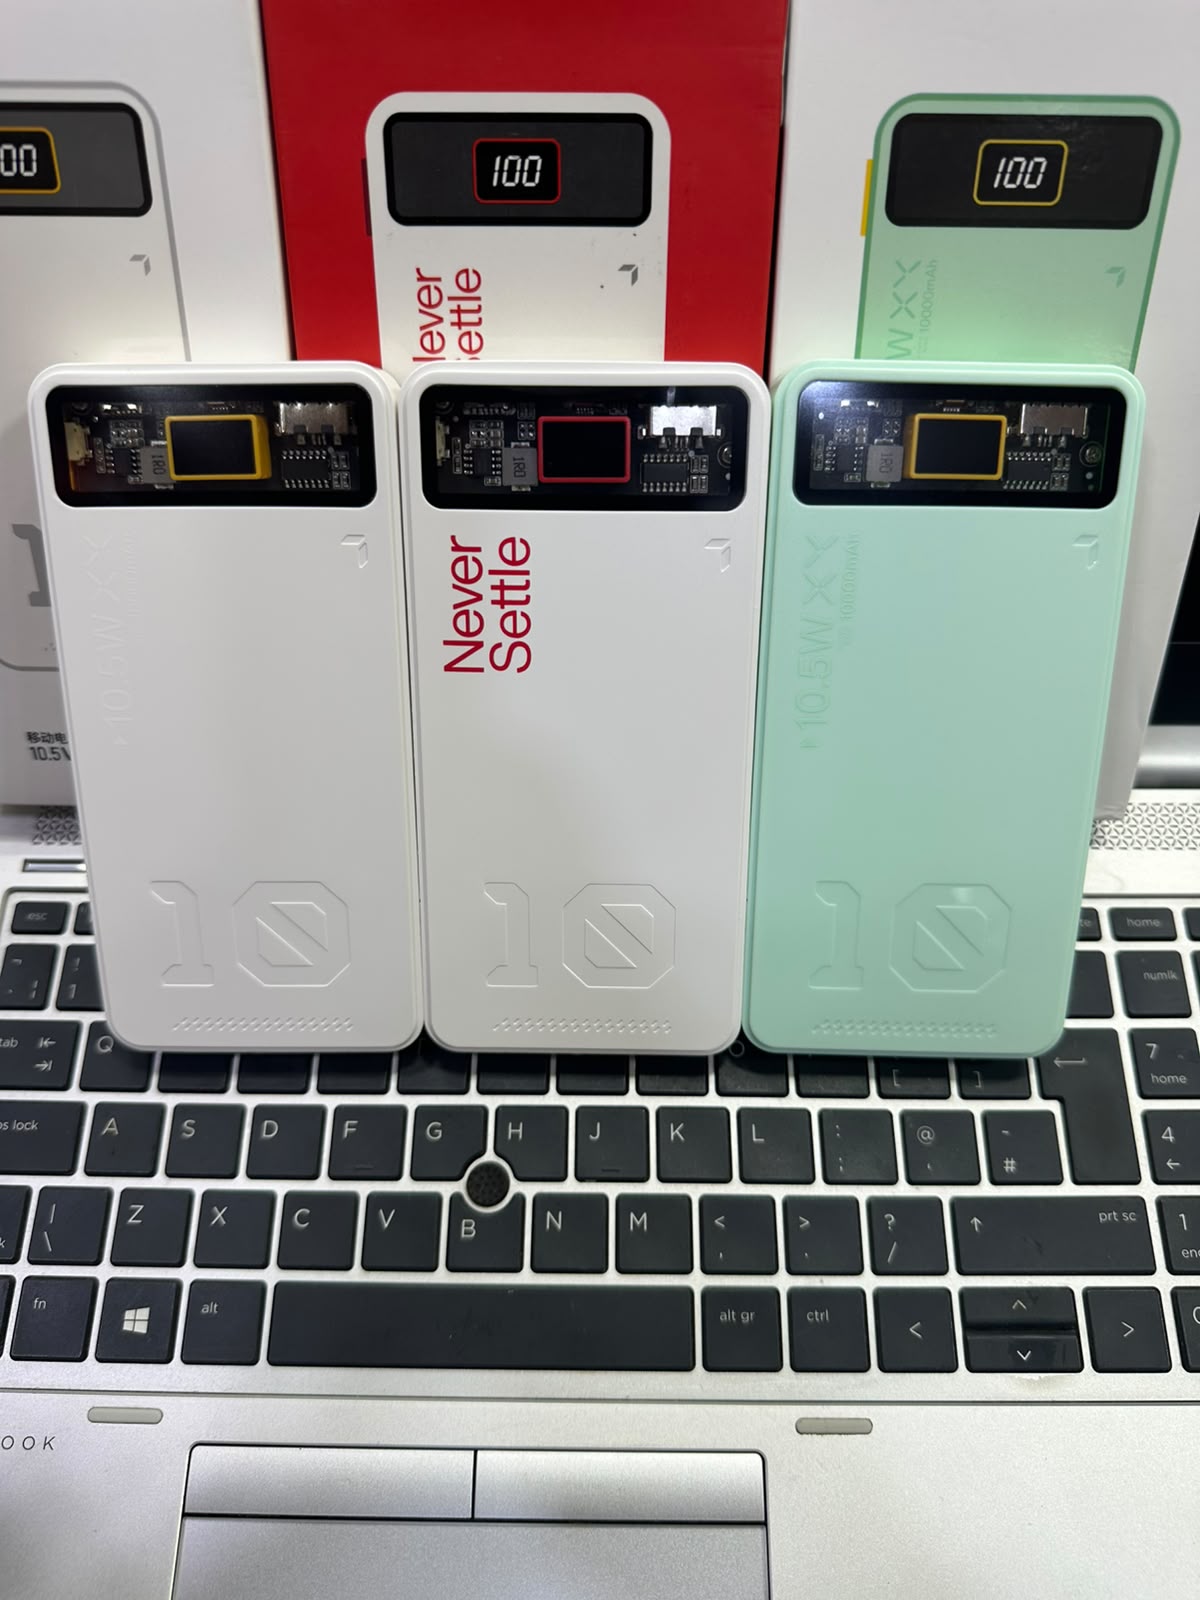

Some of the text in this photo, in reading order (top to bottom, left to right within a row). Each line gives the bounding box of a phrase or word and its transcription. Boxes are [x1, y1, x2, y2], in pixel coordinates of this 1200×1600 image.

[492, 155, 542, 187] 100
[993, 157, 1047, 188] 100
[447, 268, 484, 360] ettle
[442, 535, 485, 673] Never
[488, 536, 532, 673] Settle
[1126, 917, 1161, 928] home
[149, 881, 351, 987] 10
[484, 882, 676, 988] 10
[808, 881, 1012, 993] 10
[97, 1035, 114, 1053] Q
[1146, 1043, 1158, 1059] 7
[1150, 1073, 1188, 1085] home
[12, 1120, 39, 1131] lock
[102, 1118, 119, 1136] A
[182, 1119, 196, 1139] S
[261, 1119, 279, 1139] D
[343, 1120, 359, 1139] F
[425, 1121, 443, 1140] G
[507, 1122, 523, 1141] H
[589, 1122, 601, 1141] J
[670, 1123, 685, 1141] K
[751, 1123, 765, 1142] L
[916, 1125, 935, 1144] @
[1161, 1126, 1175, 1143] 4
[1003, 1157, 1017, 1173] #
[127, 1205, 144, 1224] Z
[210, 1206, 228, 1226] X
[292, 1208, 310, 1229] C
[378, 1209, 396, 1230] V
[546, 1211, 562, 1230] N
[630, 1212, 647, 1231] M
[884, 1214, 895, 1231] ?
[1098, 1210, 1137, 1223] prt sc
[1179, 1213, 1187, 1230] 1
[461, 1219, 477, 1238] B
[33, 1297, 47, 1310] fn
[201, 1302, 218, 1314] alt
[719, 1309, 755, 1324] alt gr
[806, 1309, 829, 1322] ctrl
